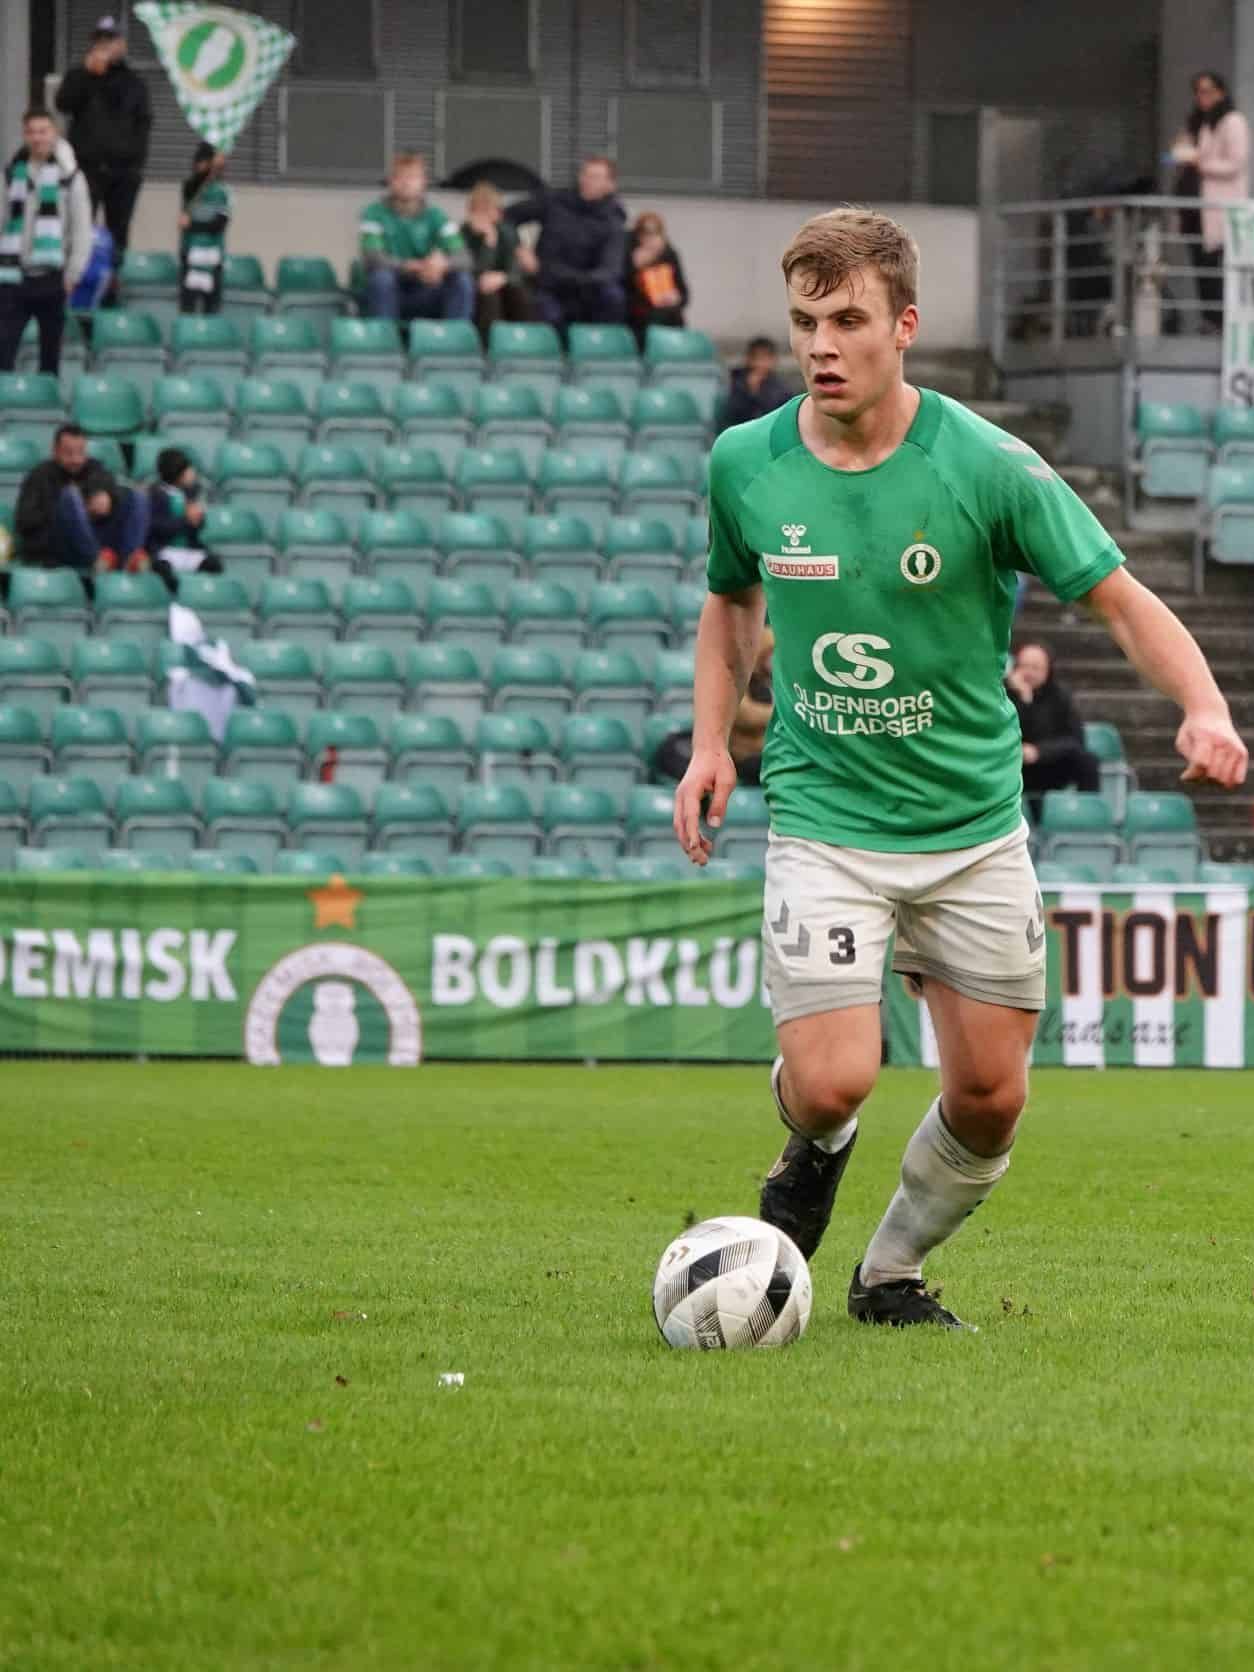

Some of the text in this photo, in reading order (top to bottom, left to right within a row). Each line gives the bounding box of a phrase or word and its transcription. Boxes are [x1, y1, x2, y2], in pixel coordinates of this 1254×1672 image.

[793, 683, 934, 718] OLDENBORG
[794, 702, 933, 738] STILLADSER
[828, 927, 856, 965] 3
[1049, 908, 1221, 1000] TION
[0, 929, 238, 1001] EMISK
[432, 934, 768, 1009] BOLDKLU
